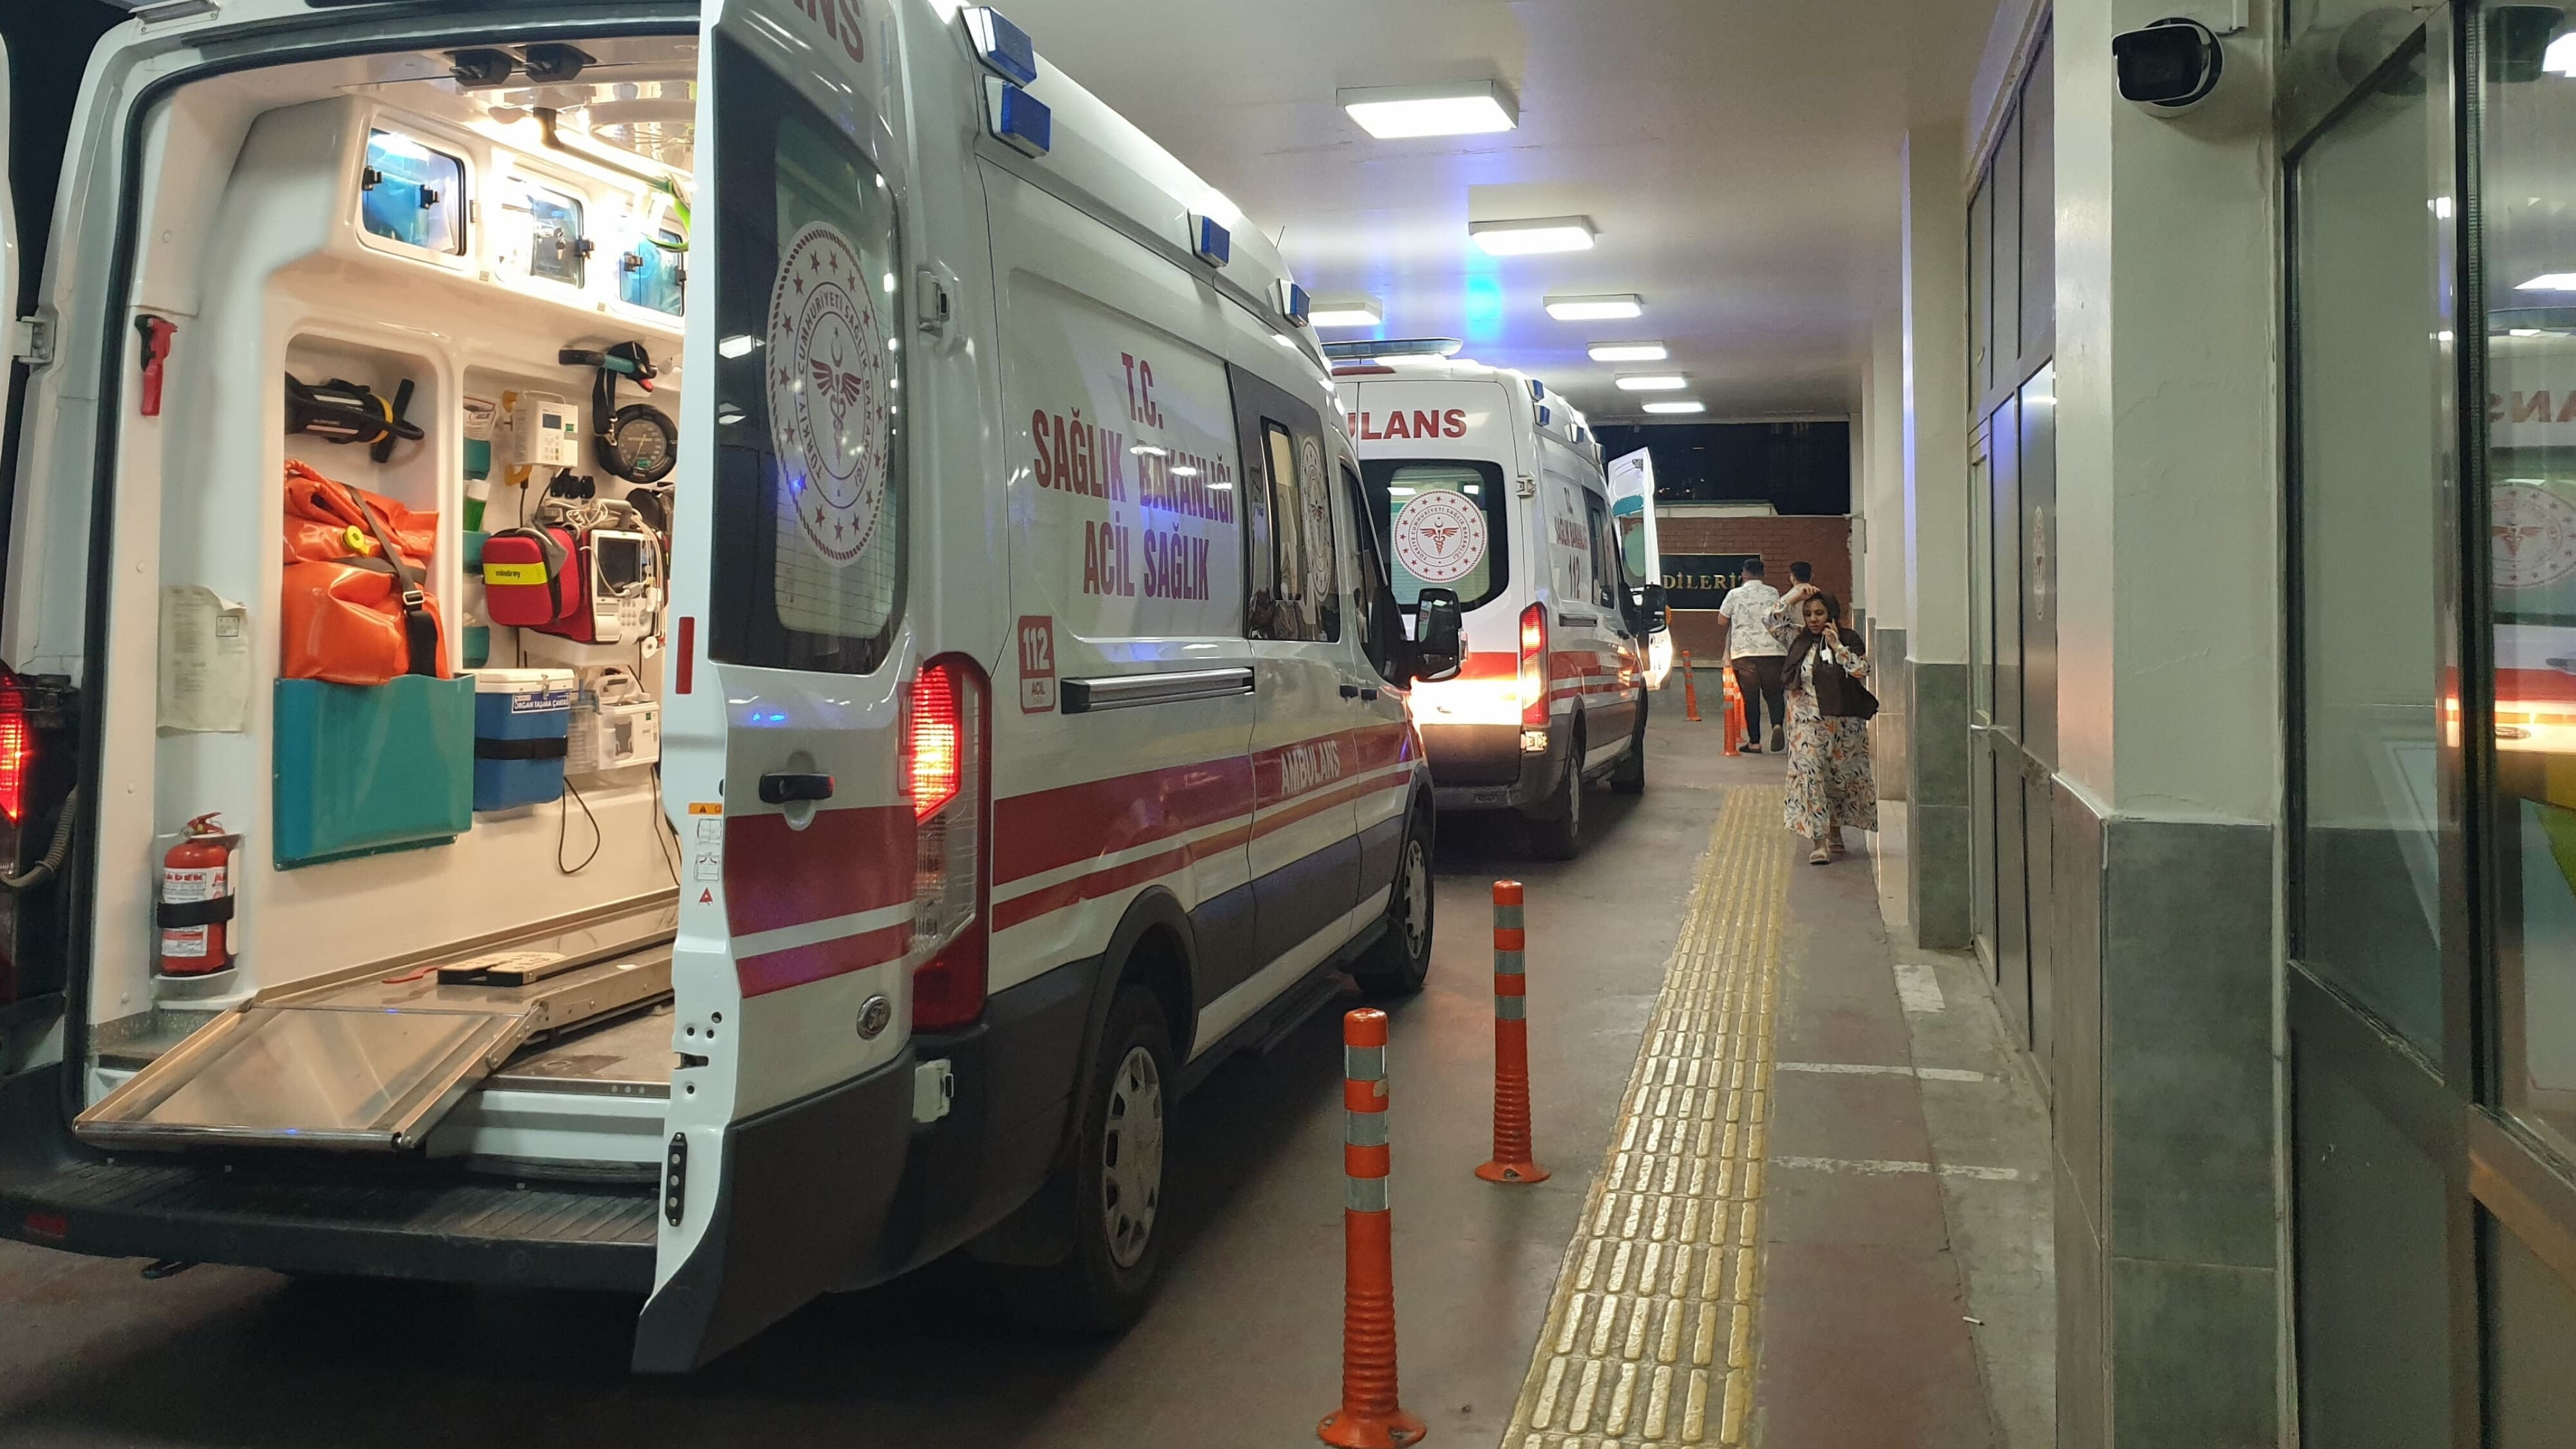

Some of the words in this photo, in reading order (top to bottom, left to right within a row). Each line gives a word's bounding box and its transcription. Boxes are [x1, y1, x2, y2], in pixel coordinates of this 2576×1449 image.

[1121, 351, 1164, 430] T.C.
[1032, 406, 1126, 502] SAĞLIK
[1136, 439, 1234, 524] BAKANLIĞI
[1083, 511, 1135, 597] ACİL
[1144, 521, 1209, 600] SAĞLIK
[1662, 571, 1741, 590] DİLERİ
[1023, 627, 1050, 670] 112
[1280, 739, 1341, 797] AMBULANS
